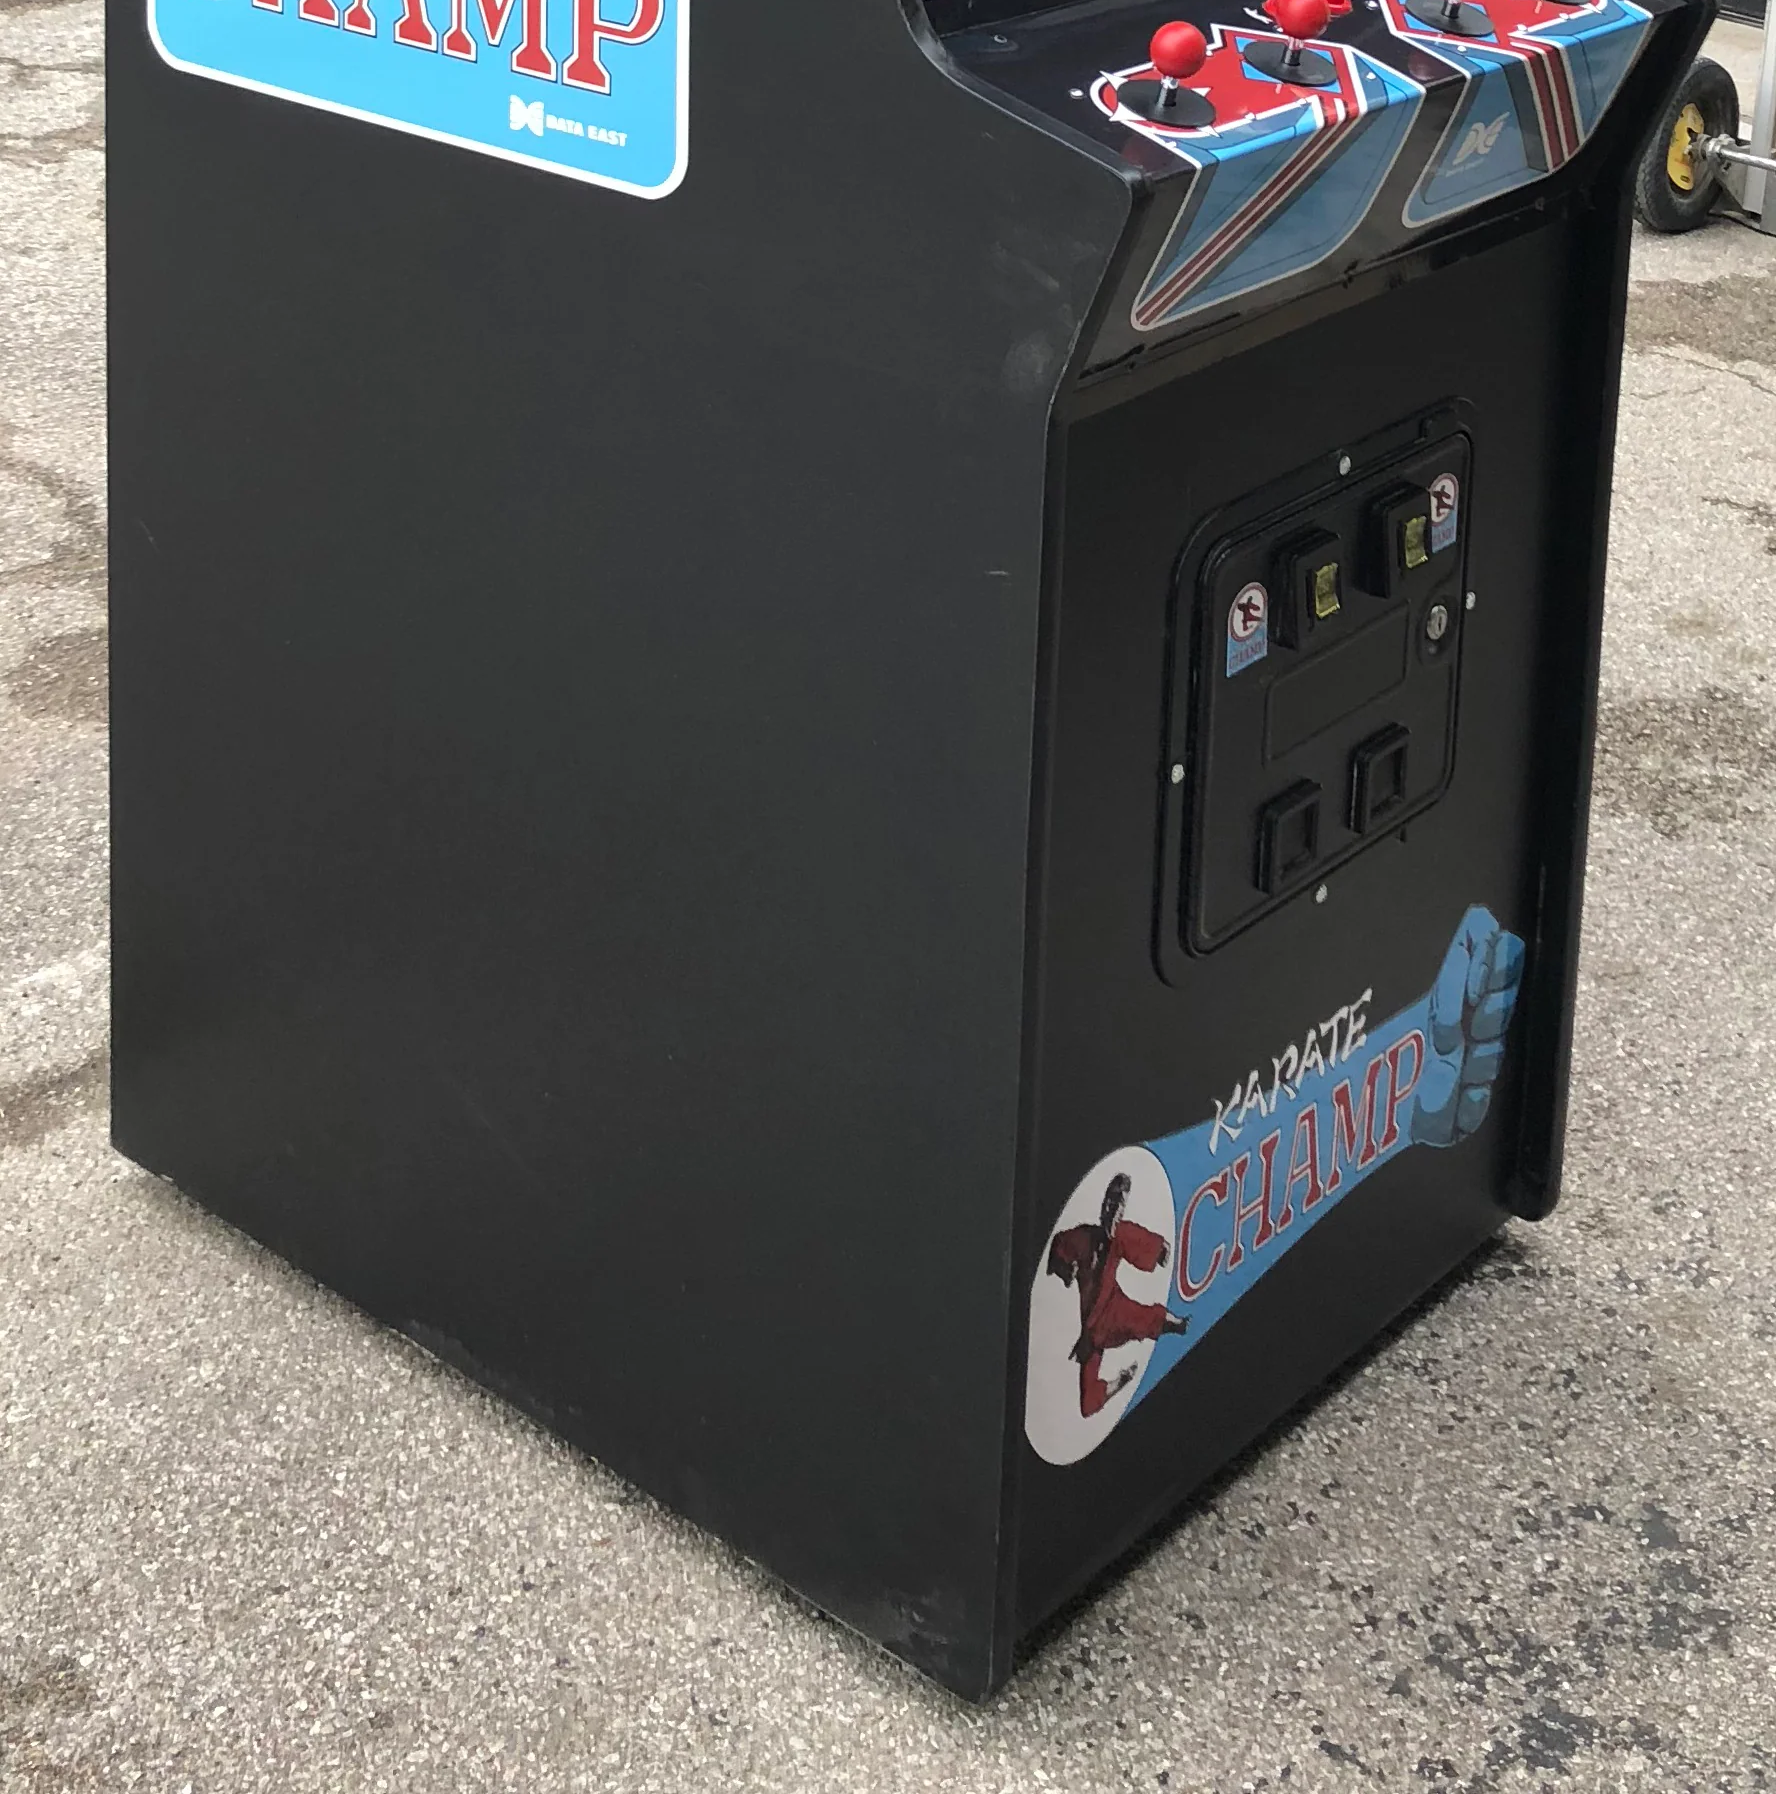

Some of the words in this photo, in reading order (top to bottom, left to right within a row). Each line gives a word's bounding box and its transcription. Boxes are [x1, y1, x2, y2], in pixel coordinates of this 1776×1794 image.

[546, 114, 585, 137] DATA
[587, 124, 628, 147] EAST
[1208, 987, 1373, 1154] KARATE
[1175, 1028, 1425, 1302] CHAMP
